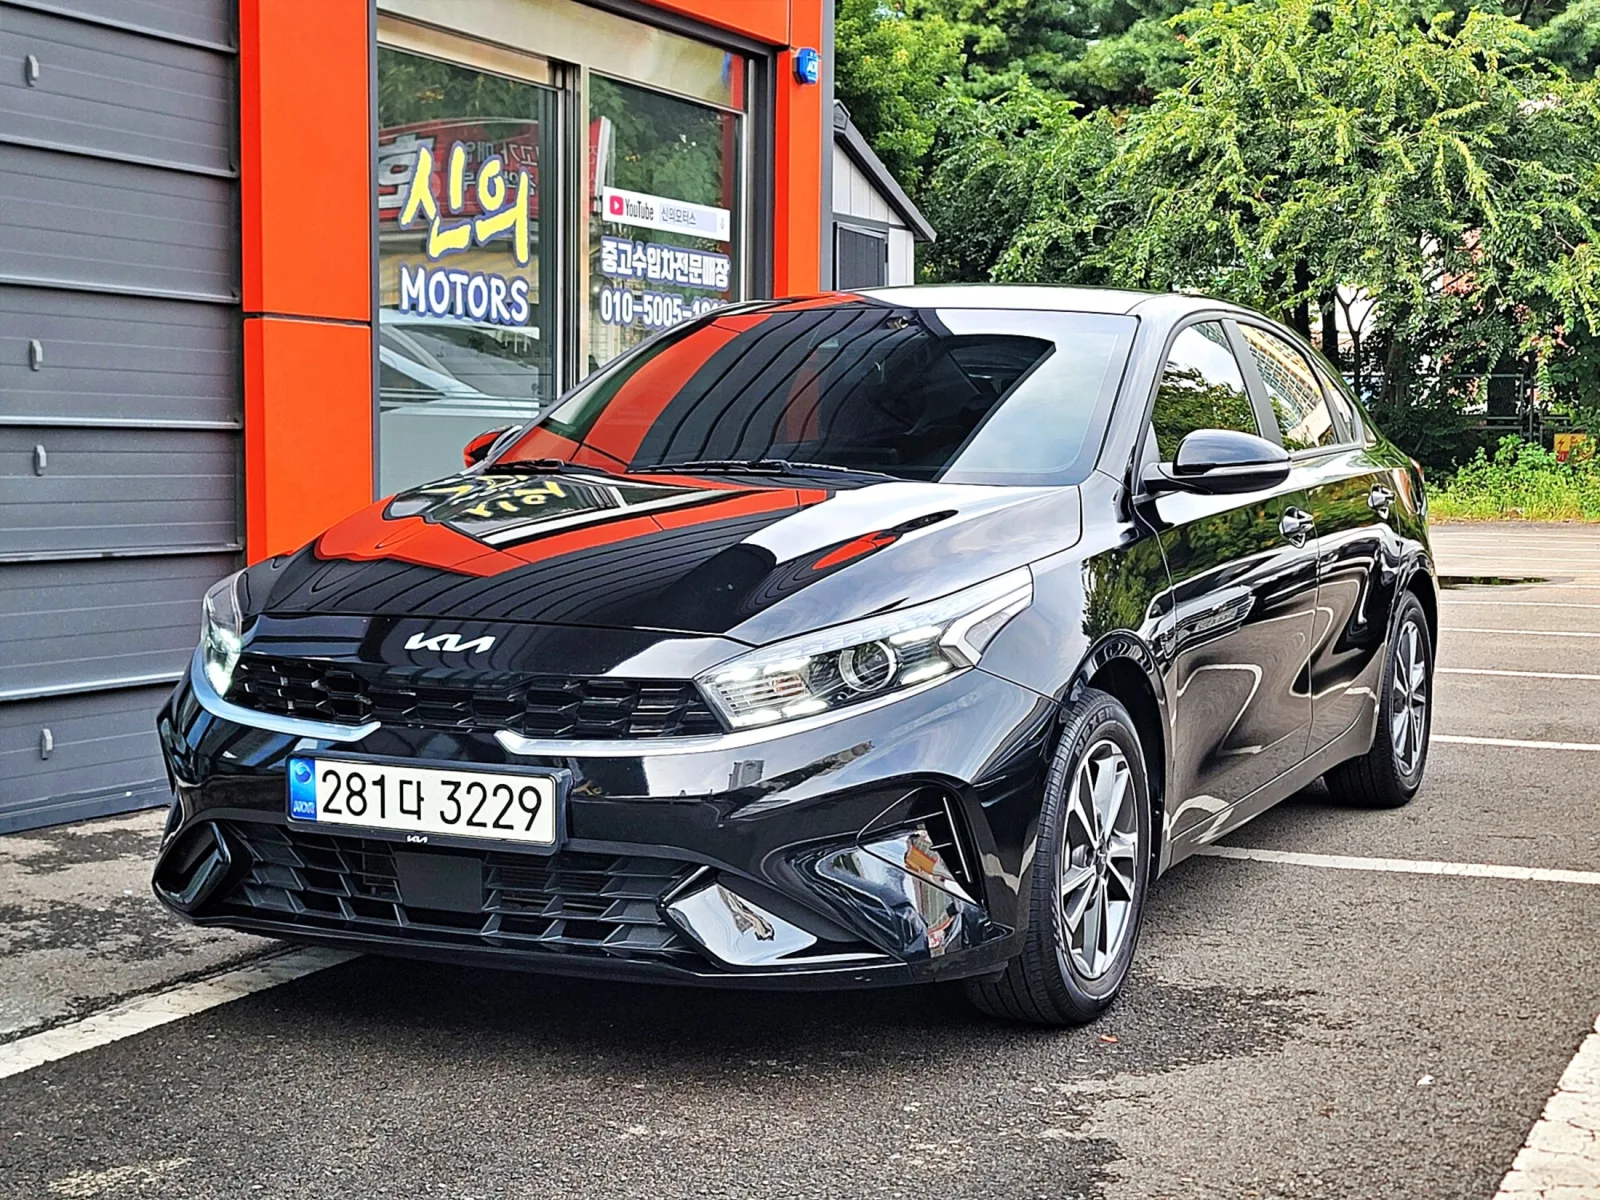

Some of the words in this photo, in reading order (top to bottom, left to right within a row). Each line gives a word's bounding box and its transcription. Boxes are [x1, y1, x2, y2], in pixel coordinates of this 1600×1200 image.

[400, 143, 530, 266] 신의
[625, 198, 654, 221] YouTube
[661, 206, 697, 225] 신의모터스
[602, 240, 730, 289] 중고수입차전문매장
[401, 266, 529, 323] MOTORS
[404, 632, 496, 654] KIA
